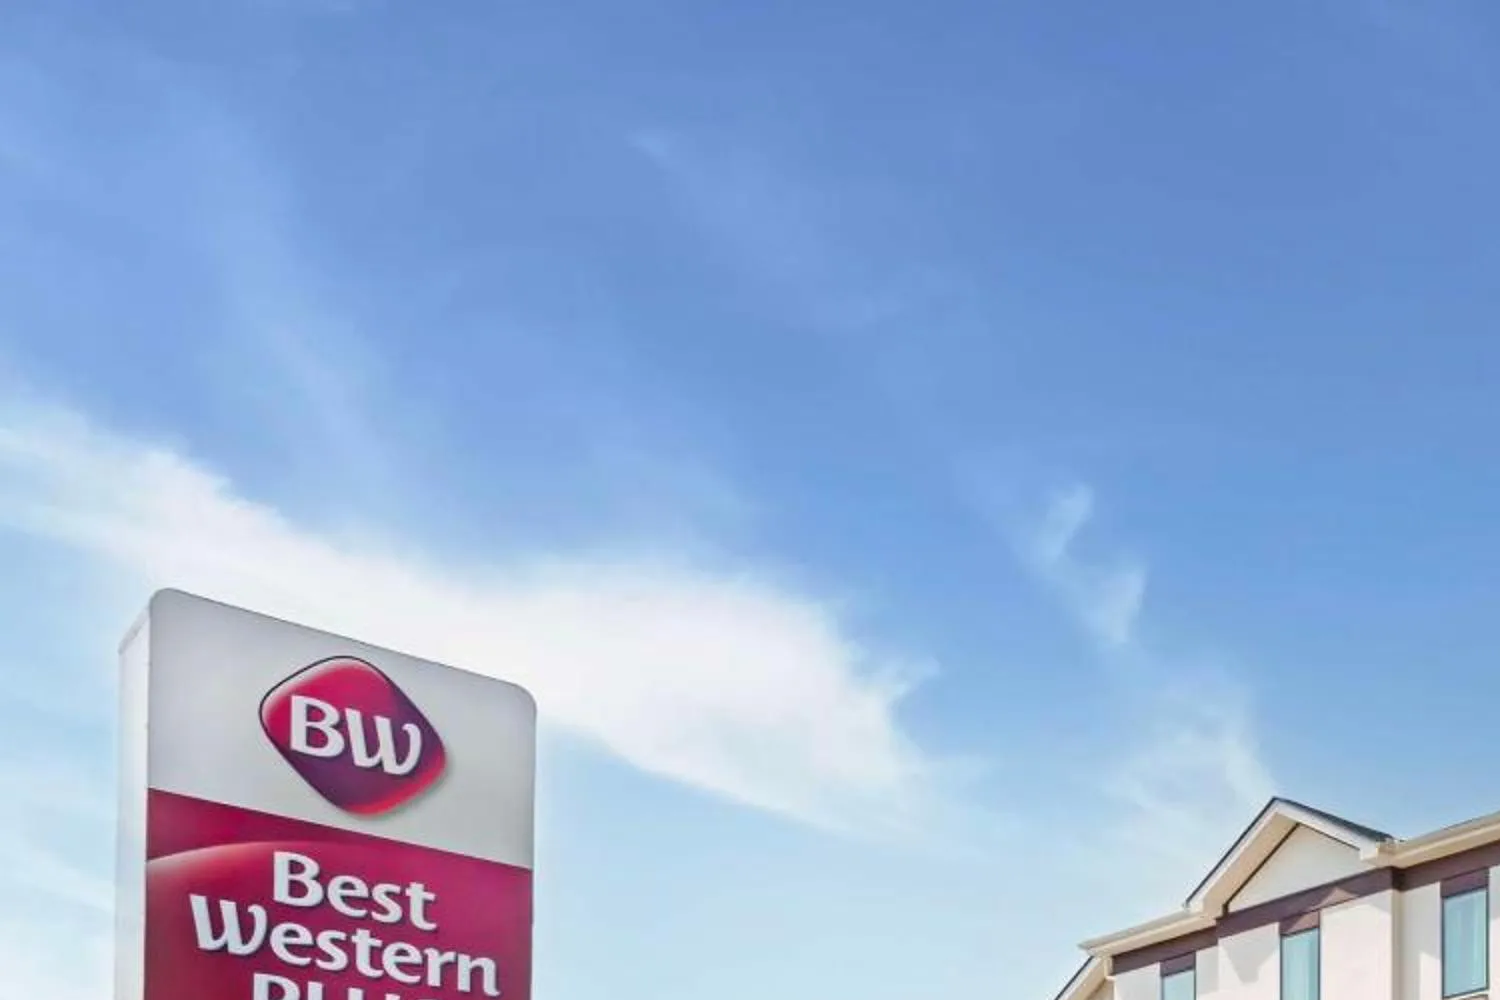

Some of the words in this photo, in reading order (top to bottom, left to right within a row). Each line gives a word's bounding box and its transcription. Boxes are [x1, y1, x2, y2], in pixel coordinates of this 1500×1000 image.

[290, 695, 423, 775] BW
[273, 851, 437, 930] Best
[190, 893, 500, 998] Western
